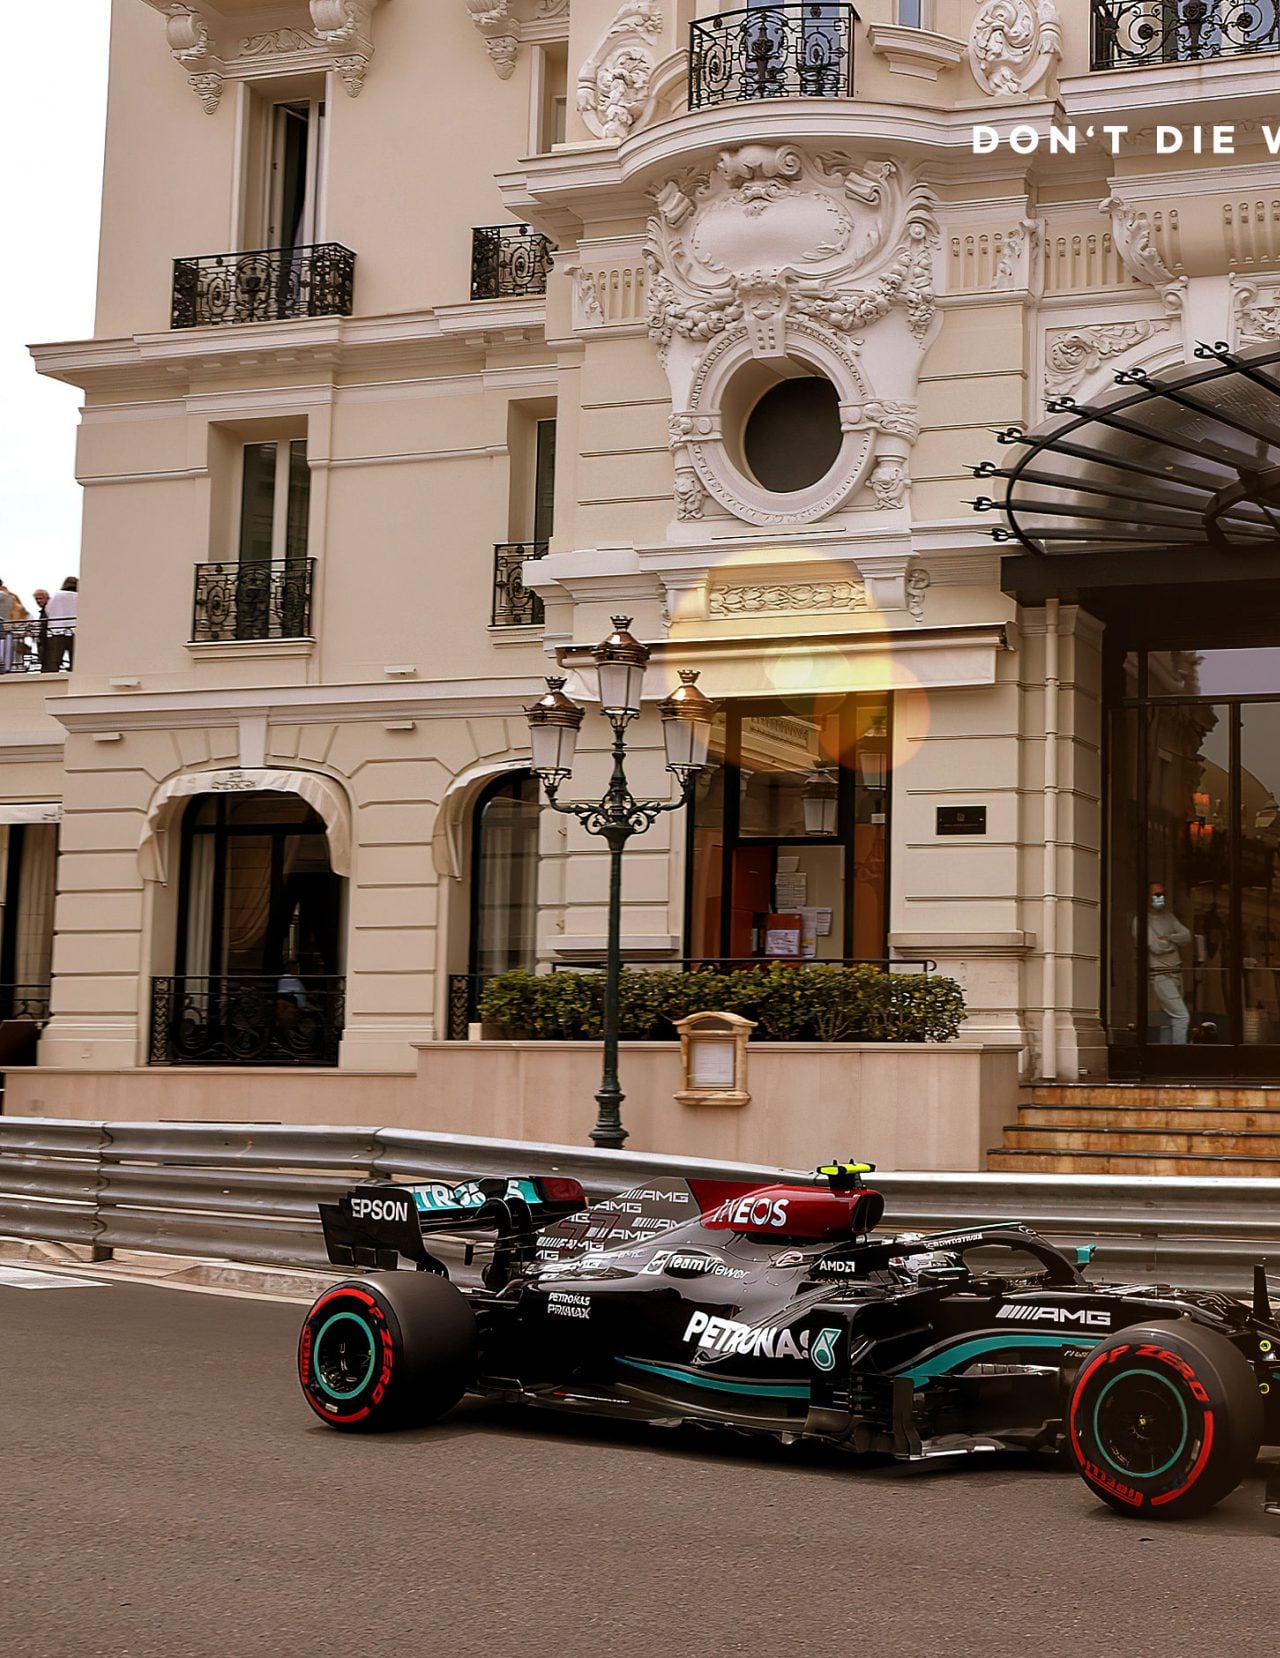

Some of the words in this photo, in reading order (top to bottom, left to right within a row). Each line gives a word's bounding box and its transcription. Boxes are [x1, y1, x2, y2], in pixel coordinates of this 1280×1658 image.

[640, 1190, 690, 1203] AMG
[351, 1198, 409, 1223] EPSON
[711, 1197, 790, 1228] INEOS
[669, 1255, 750, 1279] TeamViewer
[819, 1260, 845, 1272] AMD
[1033, 1307, 1112, 1326] AMG
[682, 1311, 810, 1360] PETRONAS
[1108, 1344, 1131, 1363] P
[1135, 1343, 1211, 1402] ZERO
